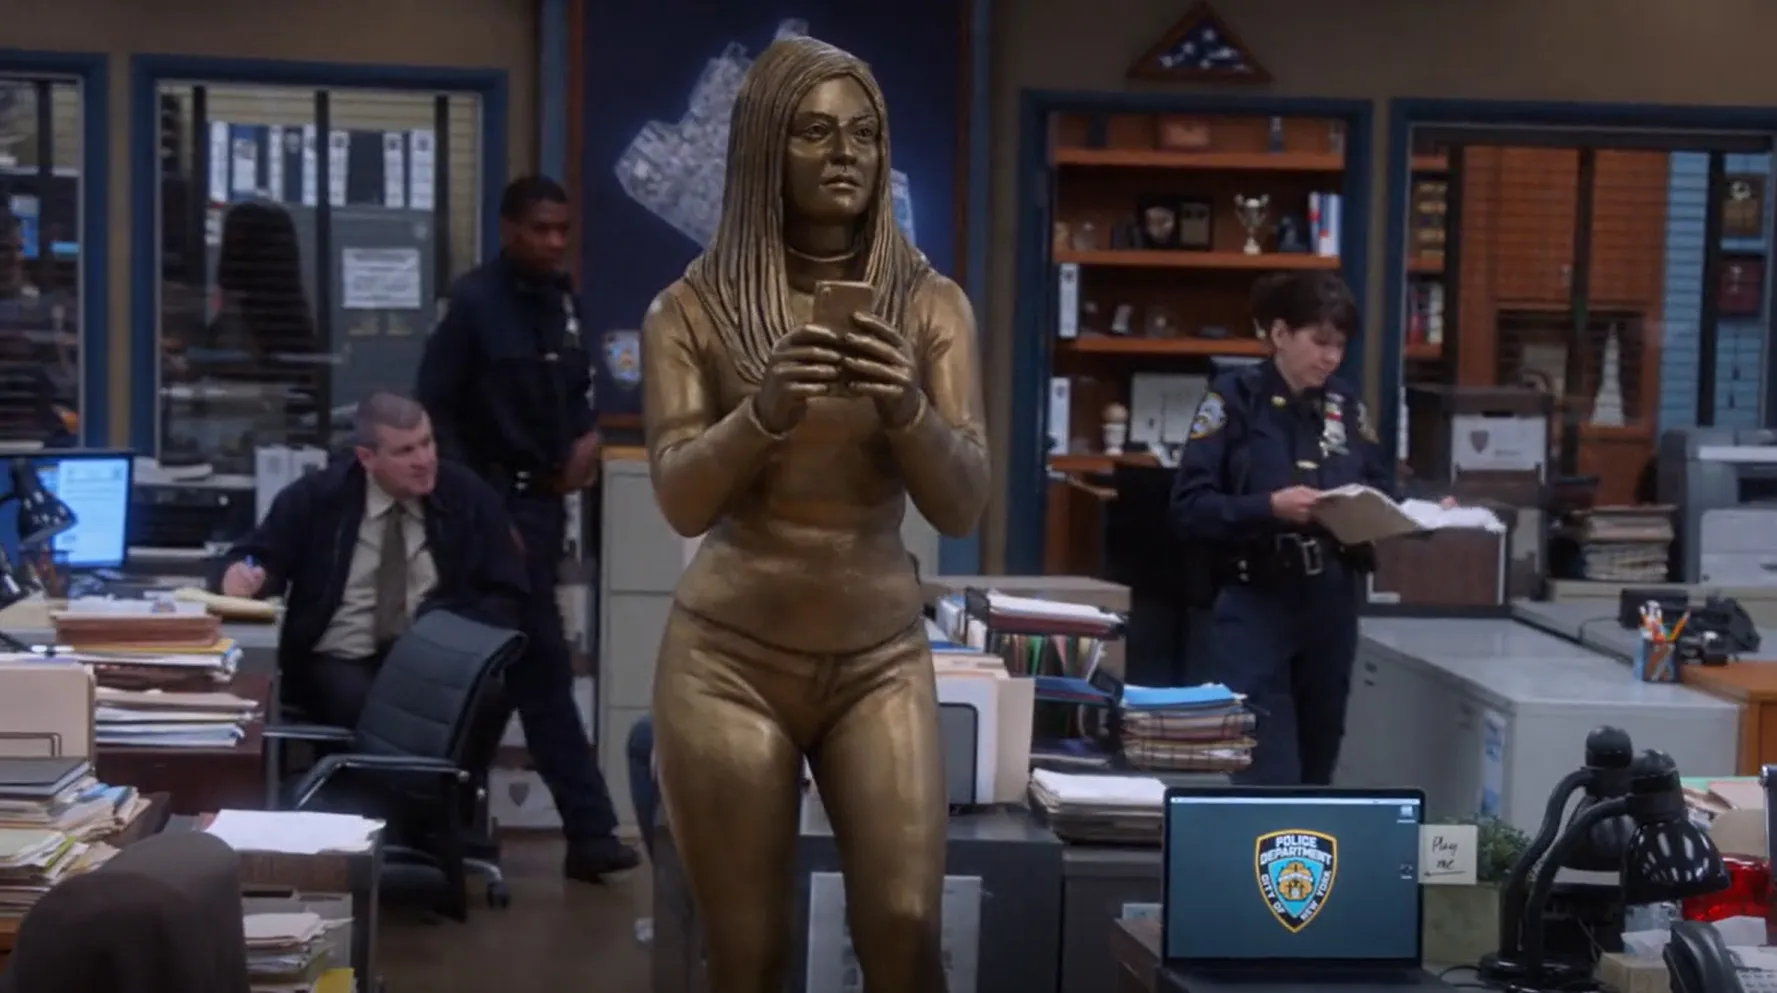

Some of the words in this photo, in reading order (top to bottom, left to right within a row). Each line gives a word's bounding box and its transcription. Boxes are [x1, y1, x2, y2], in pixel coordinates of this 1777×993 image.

[1275, 834, 1318, 849] POLICE
[1432, 835, 1458, 857] Play
[1260, 846, 1332, 865] DEPARTMENT
[1261, 873, 1275, 898] CITY
[1273, 901, 1286, 914] OF
[1300, 900, 1319, 920] NEW
[1316, 870, 1332, 896] YORK
